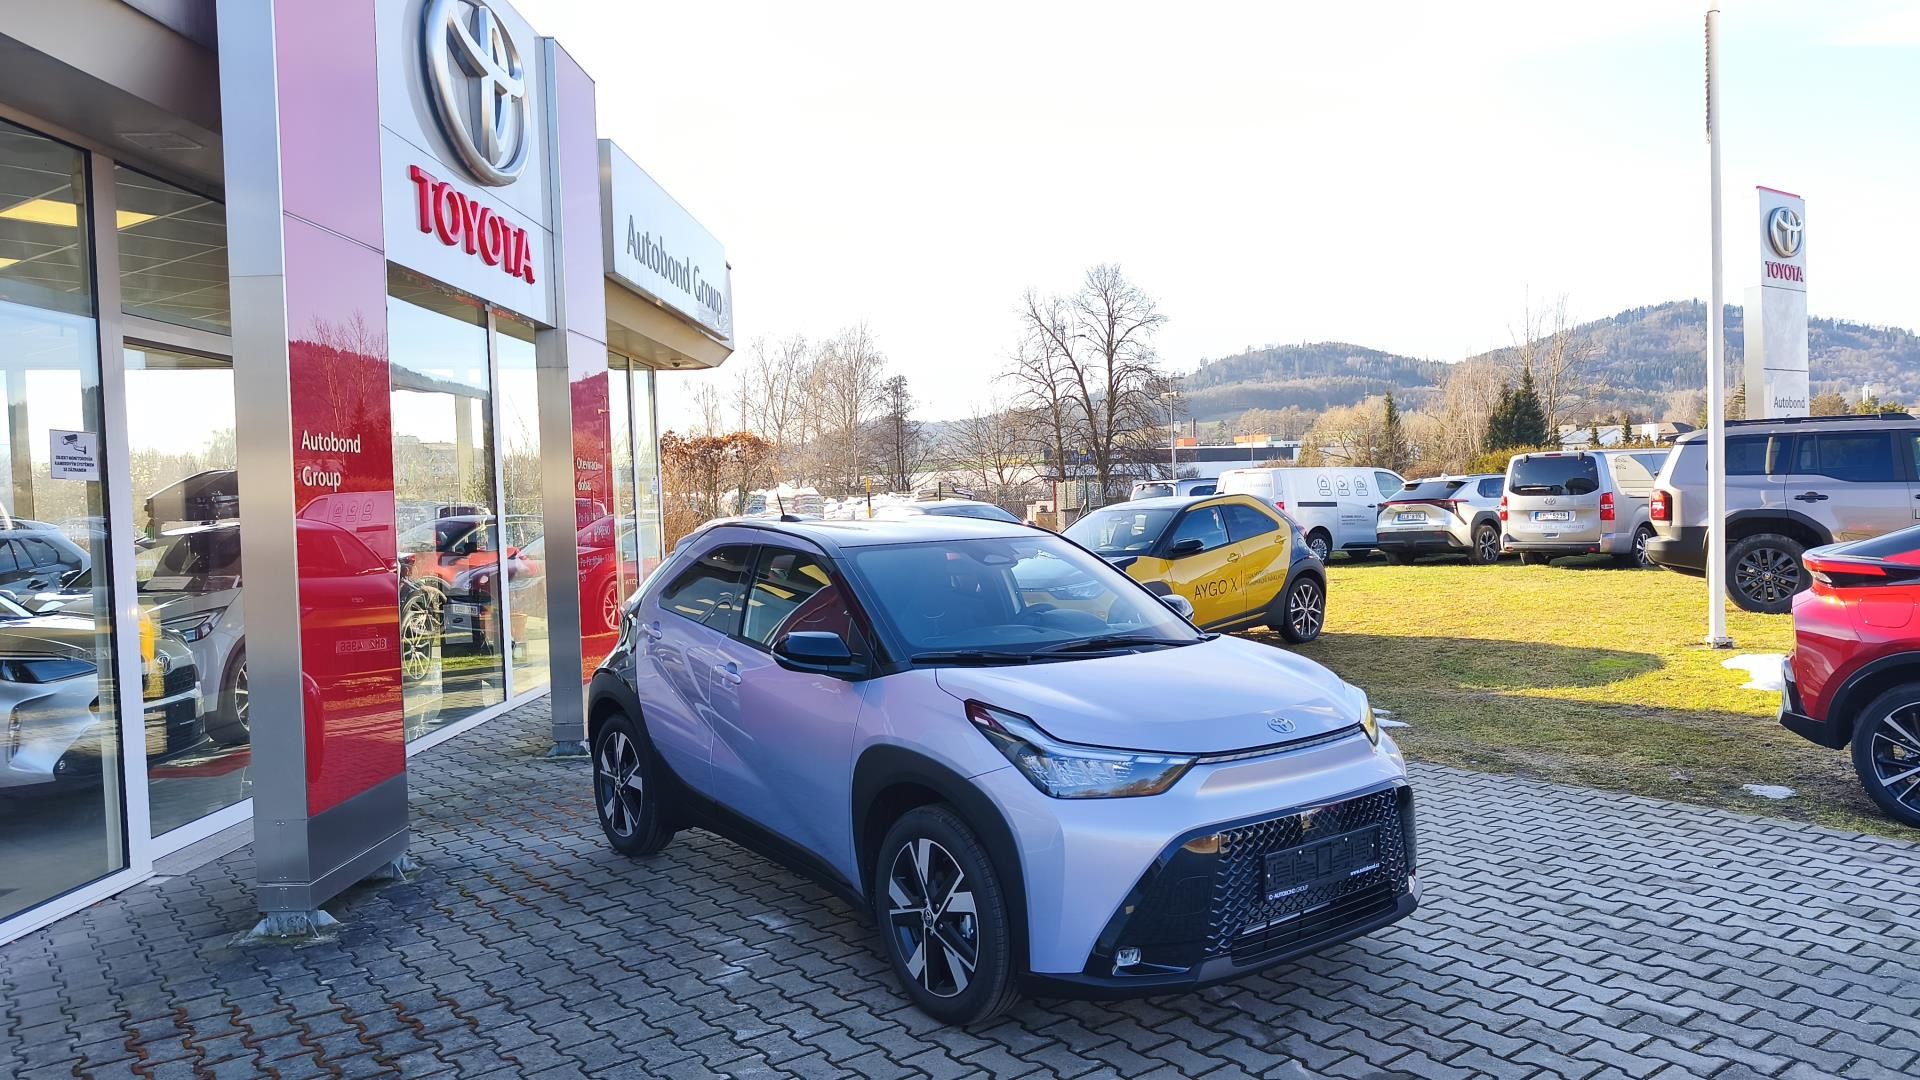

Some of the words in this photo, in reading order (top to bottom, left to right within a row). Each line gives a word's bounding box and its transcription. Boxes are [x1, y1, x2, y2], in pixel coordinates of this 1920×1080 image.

[408, 164, 536, 285] TOYOTA
[627, 214, 690, 294] Autobond
[693, 265, 722, 325] Group
[1765, 260, 1804, 282] TOYOTA
[1773, 395, 1806, 409] Autobond
[301, 429, 361, 453] Autobond
[302, 465, 342, 493] Group
[1194, 579, 1228, 601] AYGO
[1230, 577, 1238, 593] X
